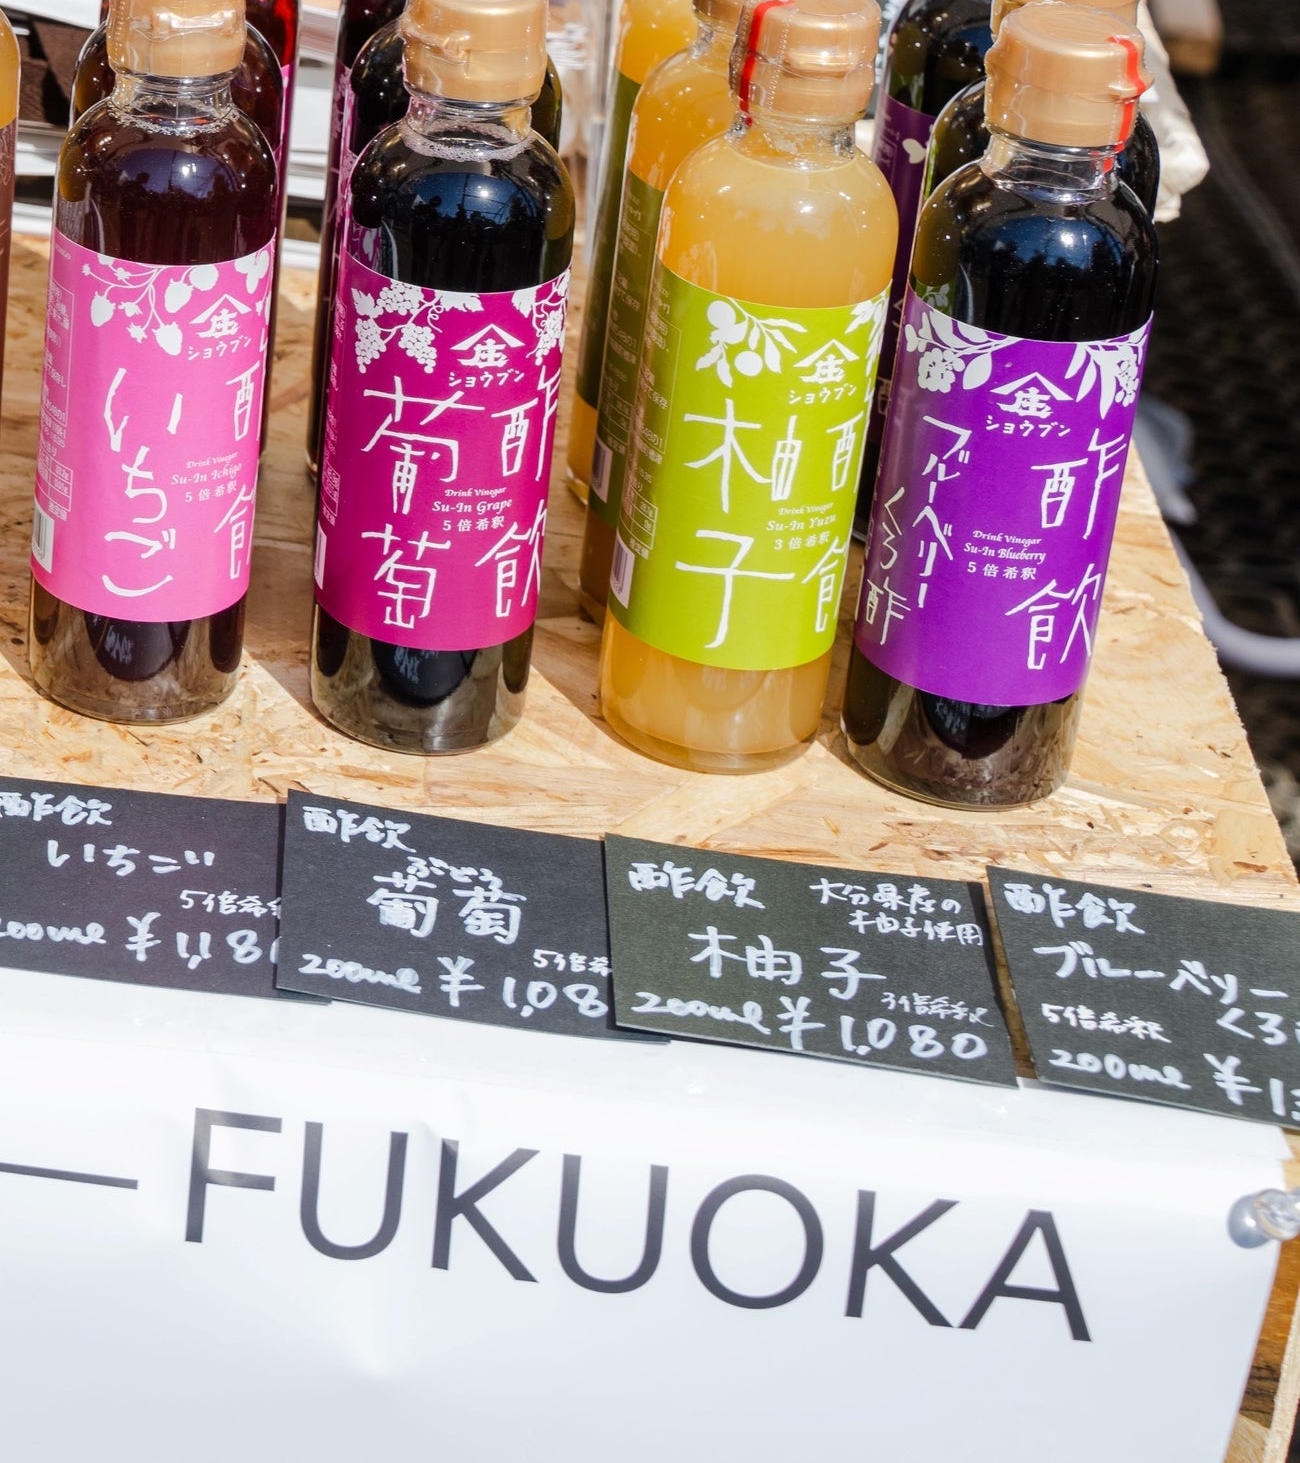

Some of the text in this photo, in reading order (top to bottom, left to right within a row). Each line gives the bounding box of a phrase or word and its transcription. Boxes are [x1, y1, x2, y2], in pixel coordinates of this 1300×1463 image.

[187, 335, 254, 361] ショウブン
[448, 370, 526, 389] ショウブン
[788, 382, 858, 405] ショウブン
[985, 414, 1072, 438] ショウブン
[102, 367, 183, 598] いちご
[170, 461, 243, 486] Su-In Ichigo
[474, 365, 562, 619] 酢飲
[360, 376, 486, 630] 葡萄
[431, 498, 513, 516] Su-In Grape
[674, 397, 803, 650] 柚子
[765, 511, 837, 533] Su-In Yuzu
[911, 415, 974, 609] ブルーベリー
[866, 486, 912, 647] くろ酢
[963, 542, 1047, 566] Su-In Blueberry
[1005, 428, 1127, 671] 酢飲
[302, 805, 417, 853] 酢飲
[47, 839, 216, 876] いちご
[365, 871, 528, 945] 葡萄
[628, 860, 766, 910] 酢飲
[808, 877, 962, 914] 大分県産の
[1003, 882, 1146, 934] 酢飲
[848, 909, 984, 947] 柚子使用
[687, 924, 887, 1001] 柚子
[1032, 940, 1289, 1005] ブルーベリー
[1216, 1007, 1300, 1047] くろ
[183, 1107, 1093, 1343] FUKUOKA
